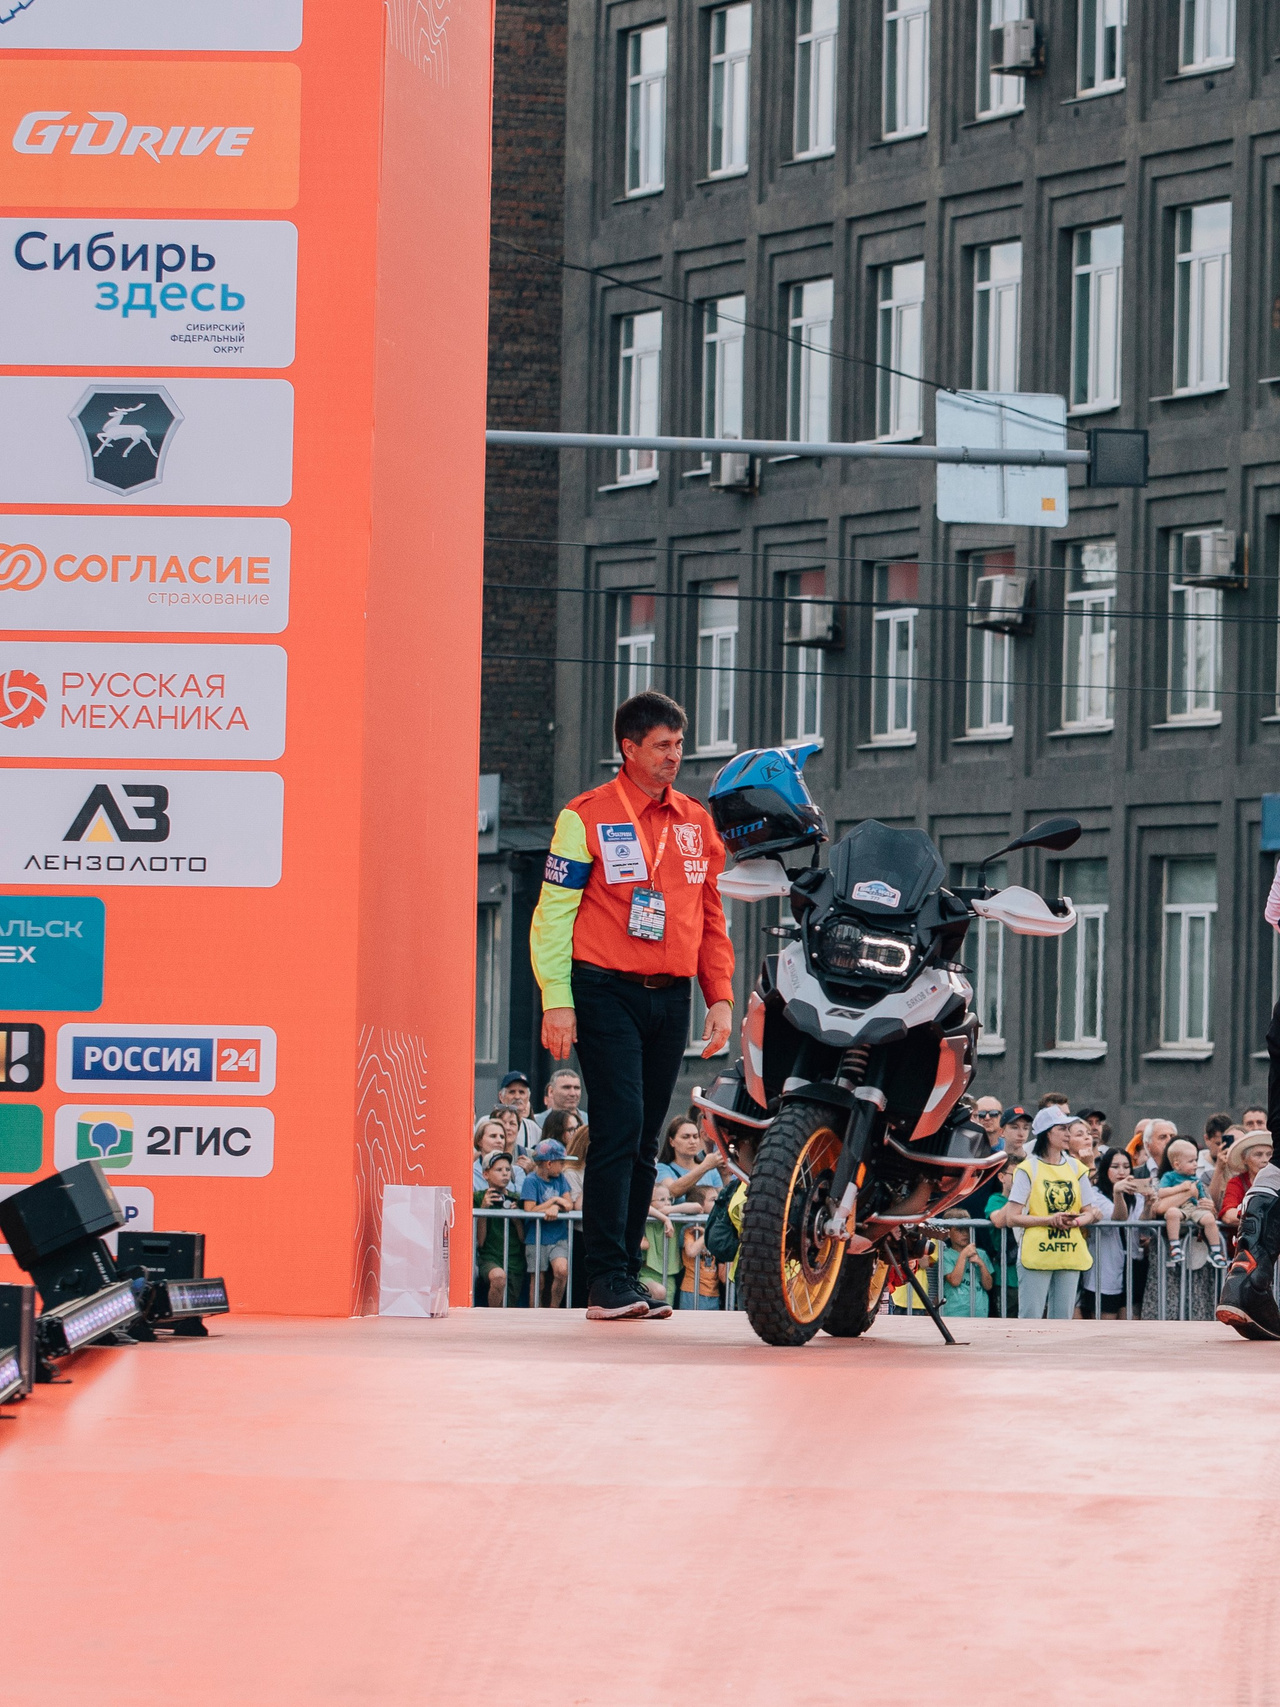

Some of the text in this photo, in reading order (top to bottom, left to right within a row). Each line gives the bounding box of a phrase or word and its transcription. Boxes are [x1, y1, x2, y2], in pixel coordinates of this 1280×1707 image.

[14, 231, 216, 282] Сибирь
[95, 282, 246, 319] здесь
[186, 322, 246, 333] СИБИРСКИЙ
[170, 333, 246, 344] ФЕДЕРАЛЬНЫЙ
[213, 345, 245, 354] ОКРУГ
[54, 554, 271, 585] СОГЛАСИЕ
[147, 591, 270, 607] страхование
[62, 672, 226, 699] РУССКАЯ
[61, 704, 250, 731] МЕХАНИКА
[24, 855, 207, 872] ЛЕНЗОЛОТО
[546, 855, 570, 873] SILK
[545, 867, 568, 883] WAY
[85, 1046, 256, 1073] РОССИЯ 24
[147, 1126, 252, 1156] 2ГИС
[1048, 1227, 1071, 1240] WAY
[1039, 1242, 1077, 1252] SAFETY
